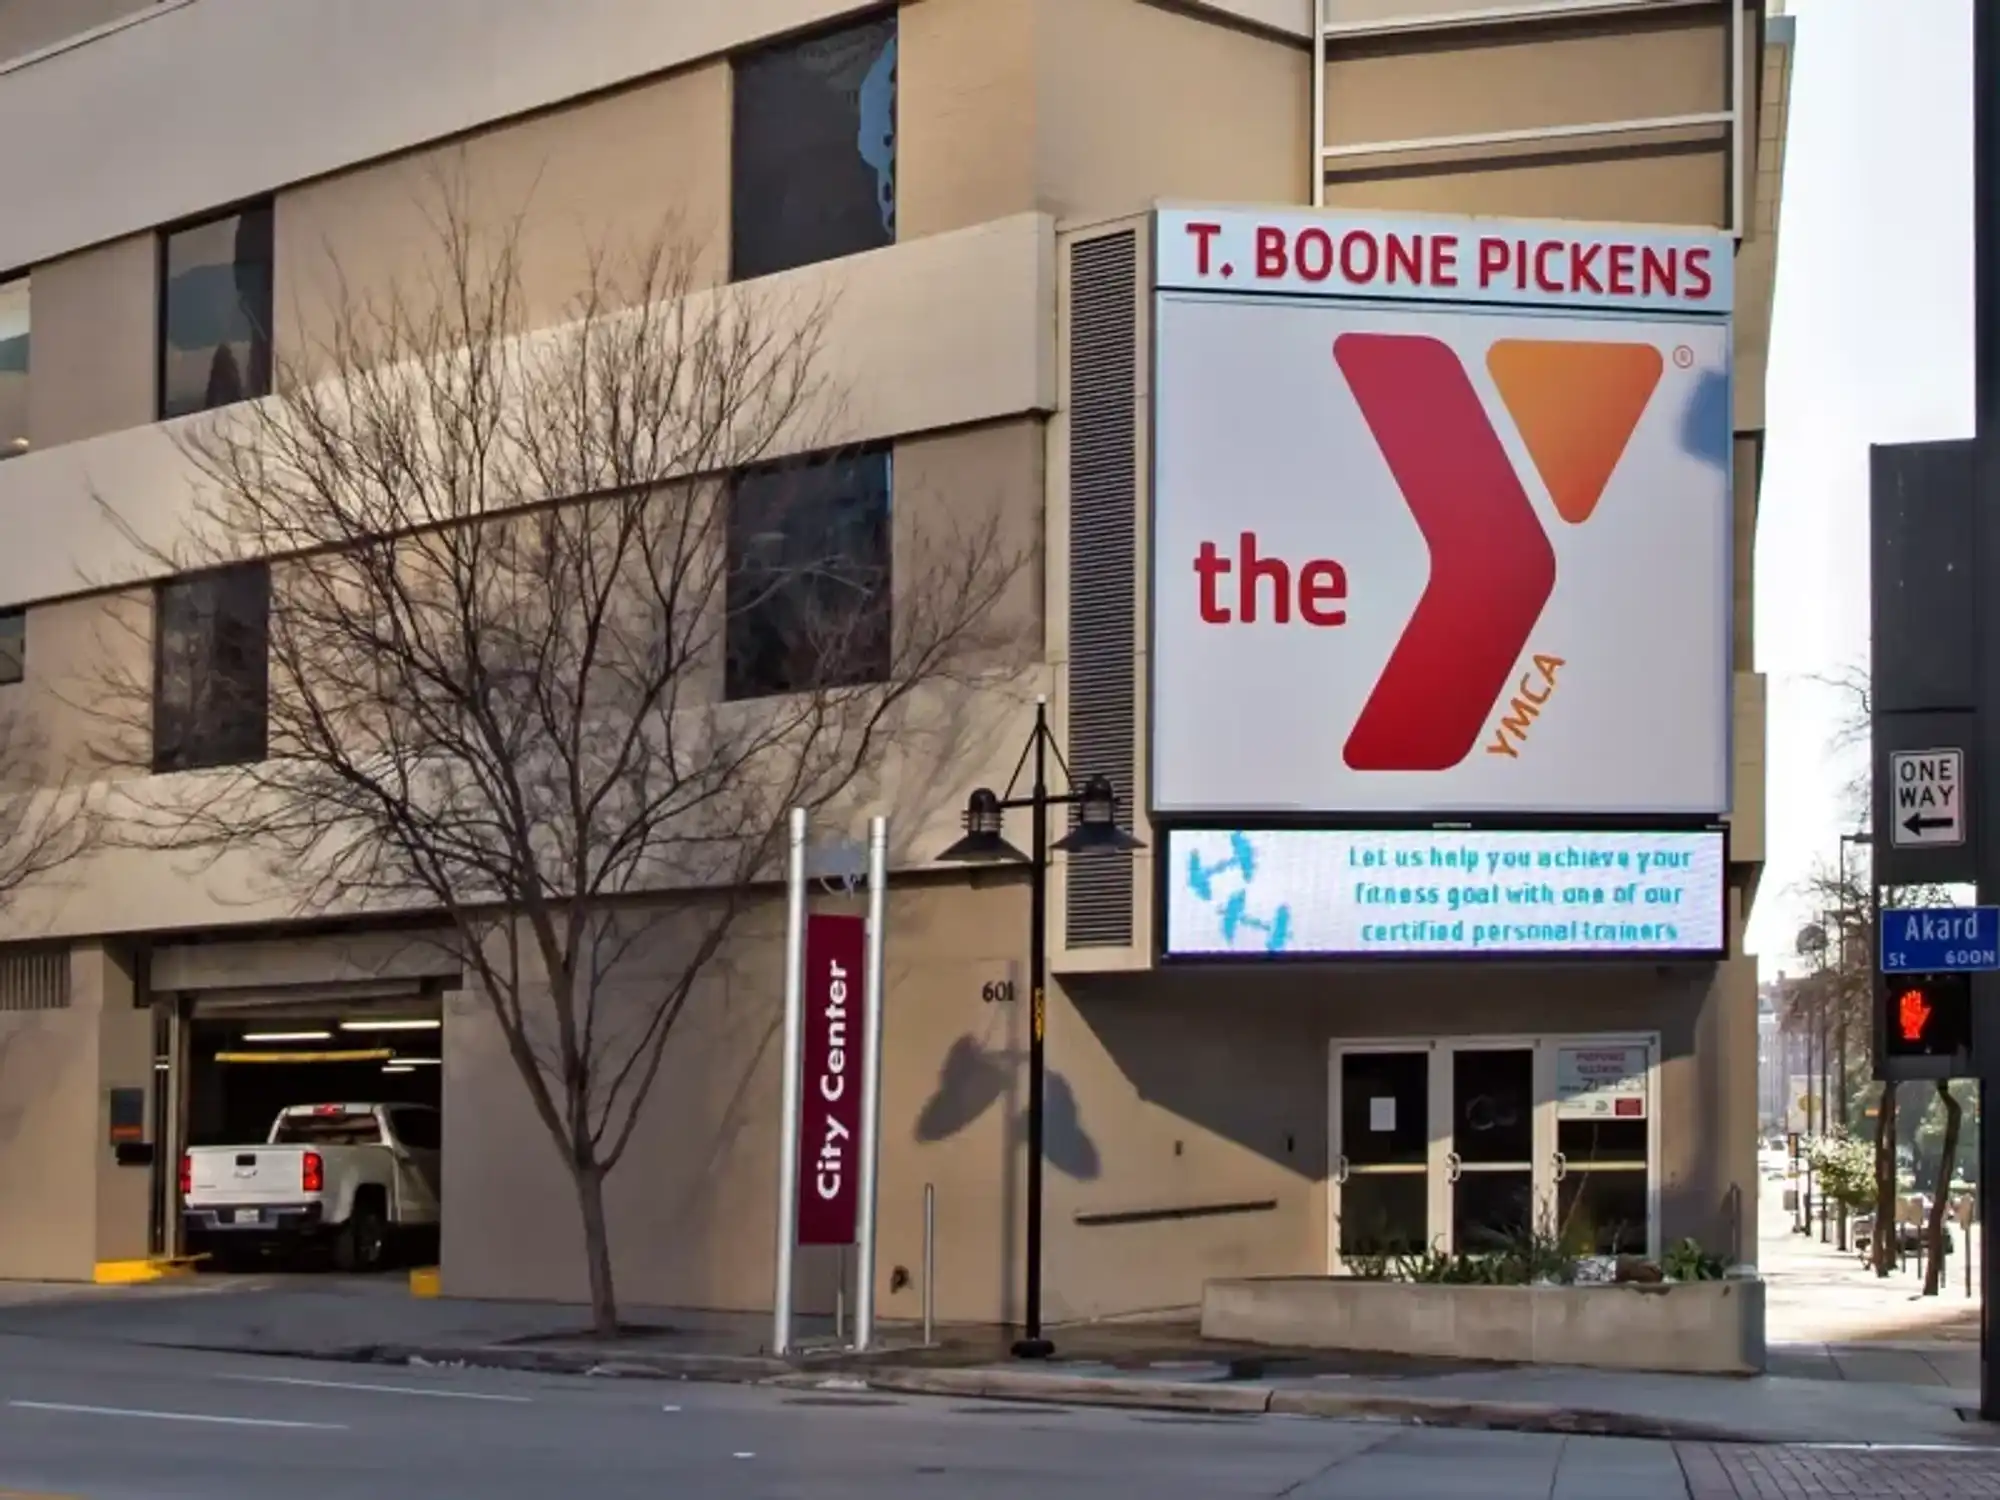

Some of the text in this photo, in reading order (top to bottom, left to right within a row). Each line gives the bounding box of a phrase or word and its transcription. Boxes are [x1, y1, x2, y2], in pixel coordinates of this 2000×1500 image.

[1186, 223, 1712, 299] T. BOONE PICKENS
[1193, 531, 1348, 627] the
[1486, 652, 1566, 760] YMCA
[1901, 759, 1952, 781] ONE
[1899, 785, 1955, 808] WAY
[1350, 846, 1692, 875] Let us help you achieve your
[1355, 882, 1683, 911] fitness goal with one of our
[1362, 920, 1679, 946] certified personal trainers
[1905, 912, 1979, 941] Akard
[1888, 949, 1996, 967] St 600N
[982, 980, 1015, 1003] 601
[816, 959, 850, 1200] City Center
